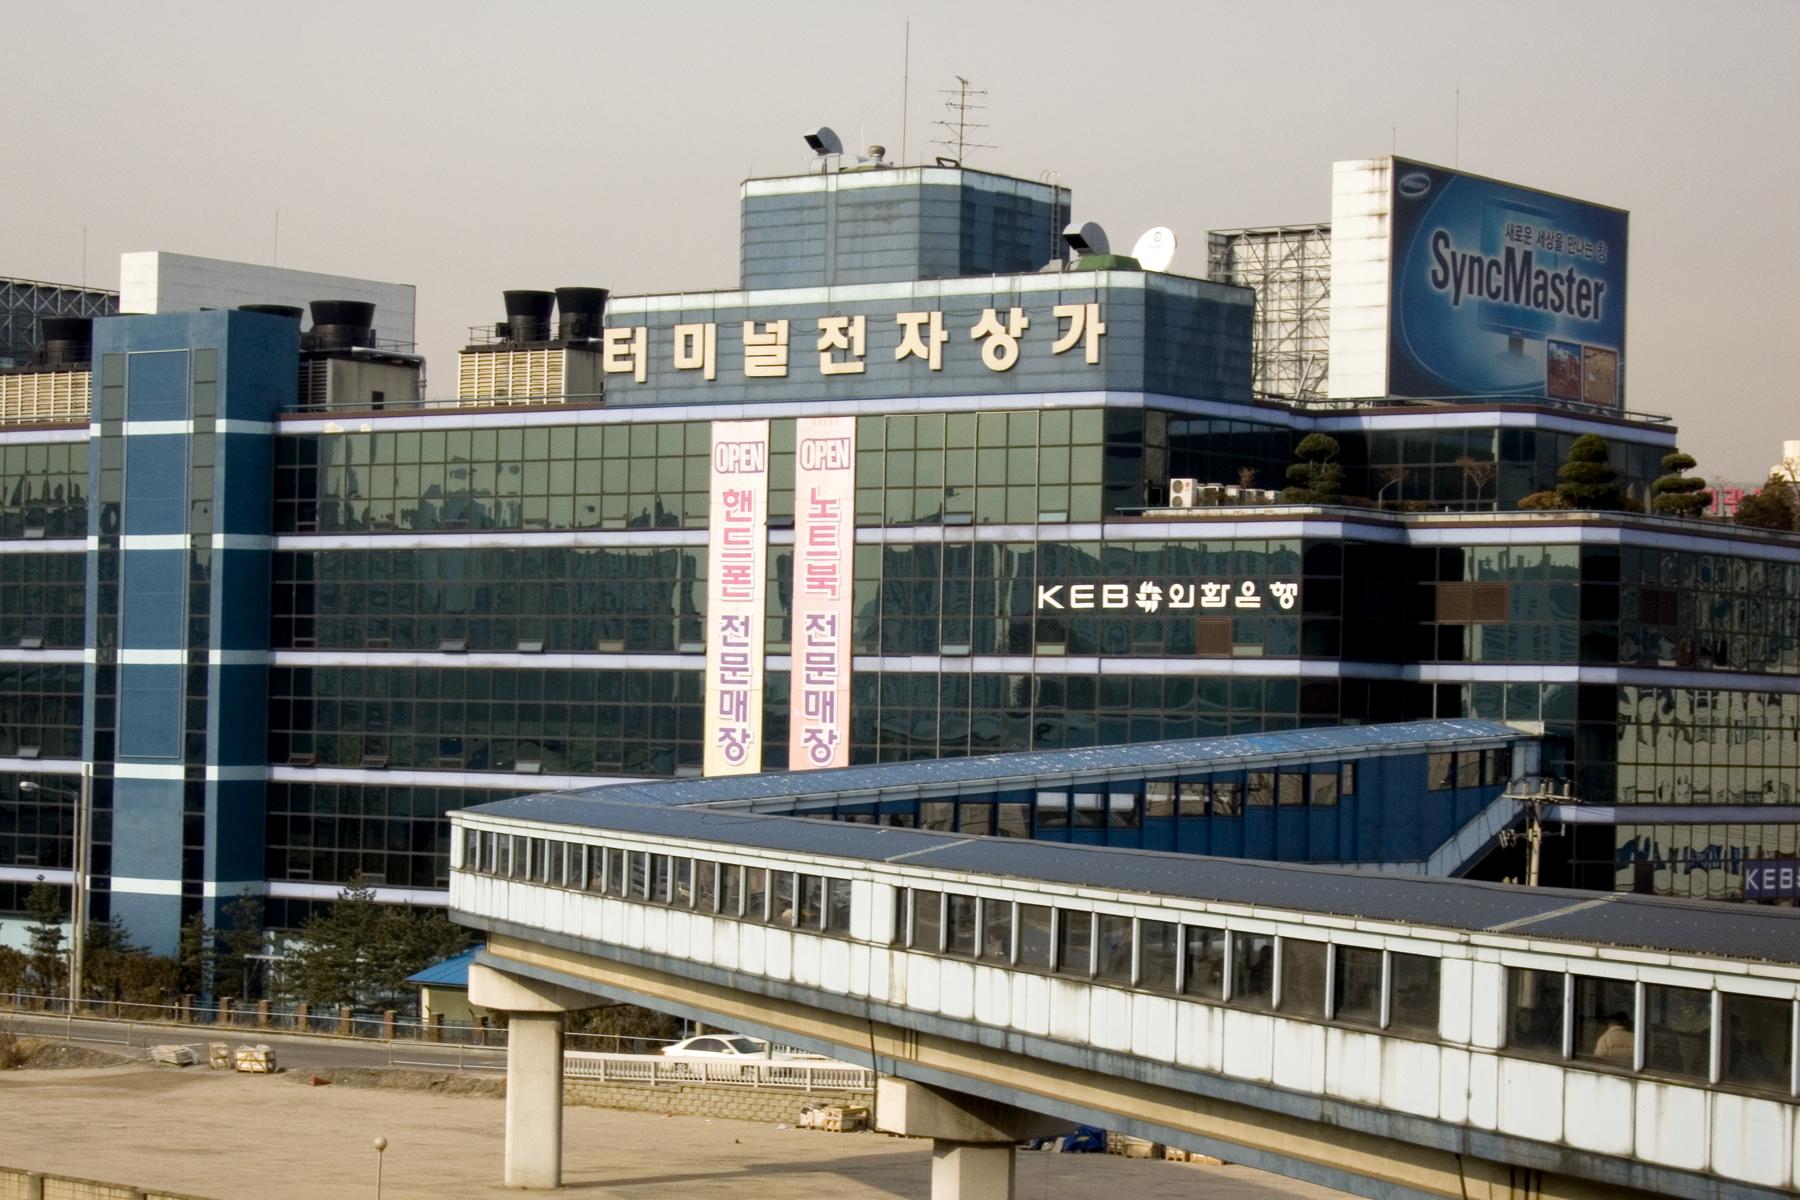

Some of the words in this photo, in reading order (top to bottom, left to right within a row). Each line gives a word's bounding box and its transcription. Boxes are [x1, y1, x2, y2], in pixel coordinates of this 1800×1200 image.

[1430, 230, 1604, 320] SyncMaster
[1504, 223, 1532, 246] 새로운
[1536, 230, 1563, 253] 세상을
[1567, 235, 1593, 258] 만나는
[603, 303, 1105, 383] 터미널전자상가
[714, 441, 765, 474] OPEN
[800, 437, 851, 471] OPEN
[722, 489, 752, 597] 핸드폰
[806, 488, 838, 596] 노트북
[1038, 584, 1129, 609] KEB
[1168, 580, 1298, 610] 외환은행
[718, 615, 750, 762] 전문매장
[804, 614, 838, 763] 전문매장
[1745, 867, 1793, 890] KEB
